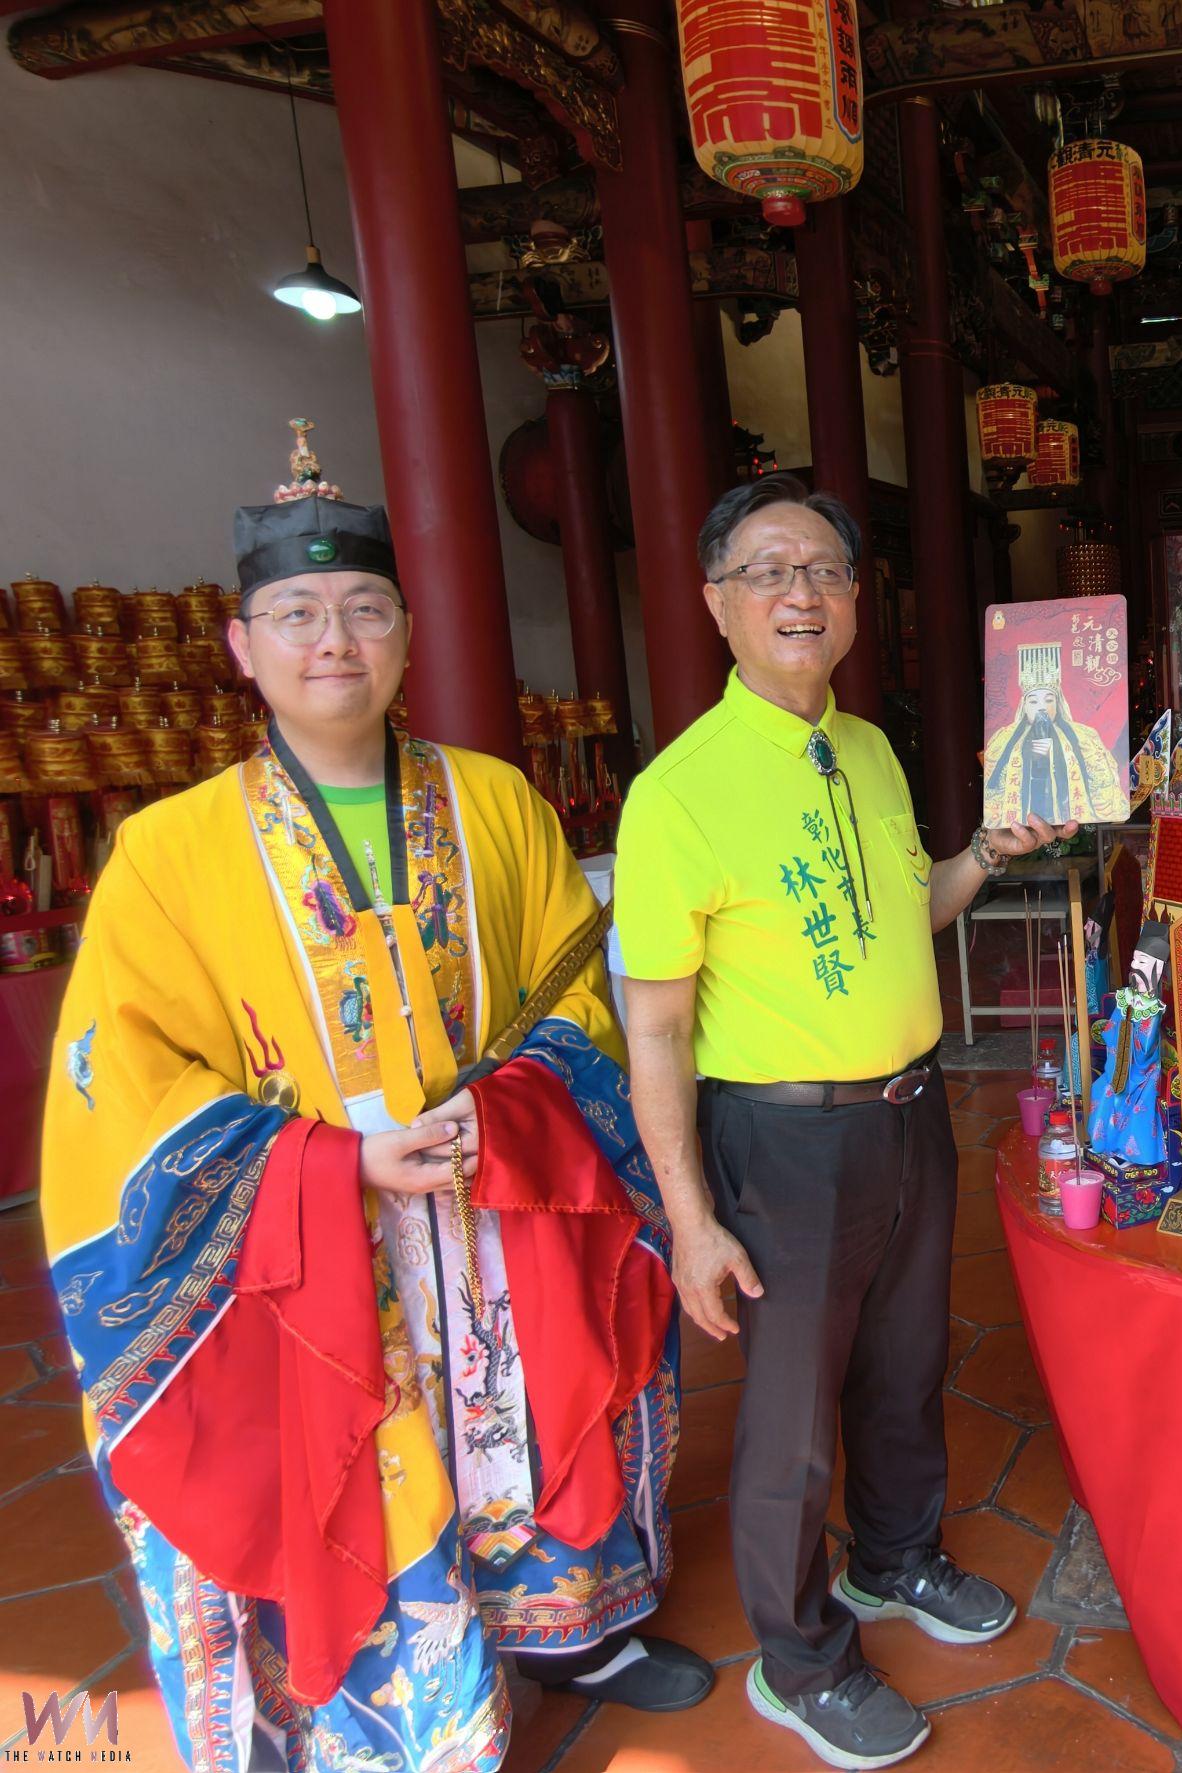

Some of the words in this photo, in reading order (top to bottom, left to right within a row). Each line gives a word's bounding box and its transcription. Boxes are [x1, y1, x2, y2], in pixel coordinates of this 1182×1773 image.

[1082, 615, 1105, 673] 元清觀
[779, 855, 855, 1001] 林世賢
[802, 809, 877, 942] 彰化市長
